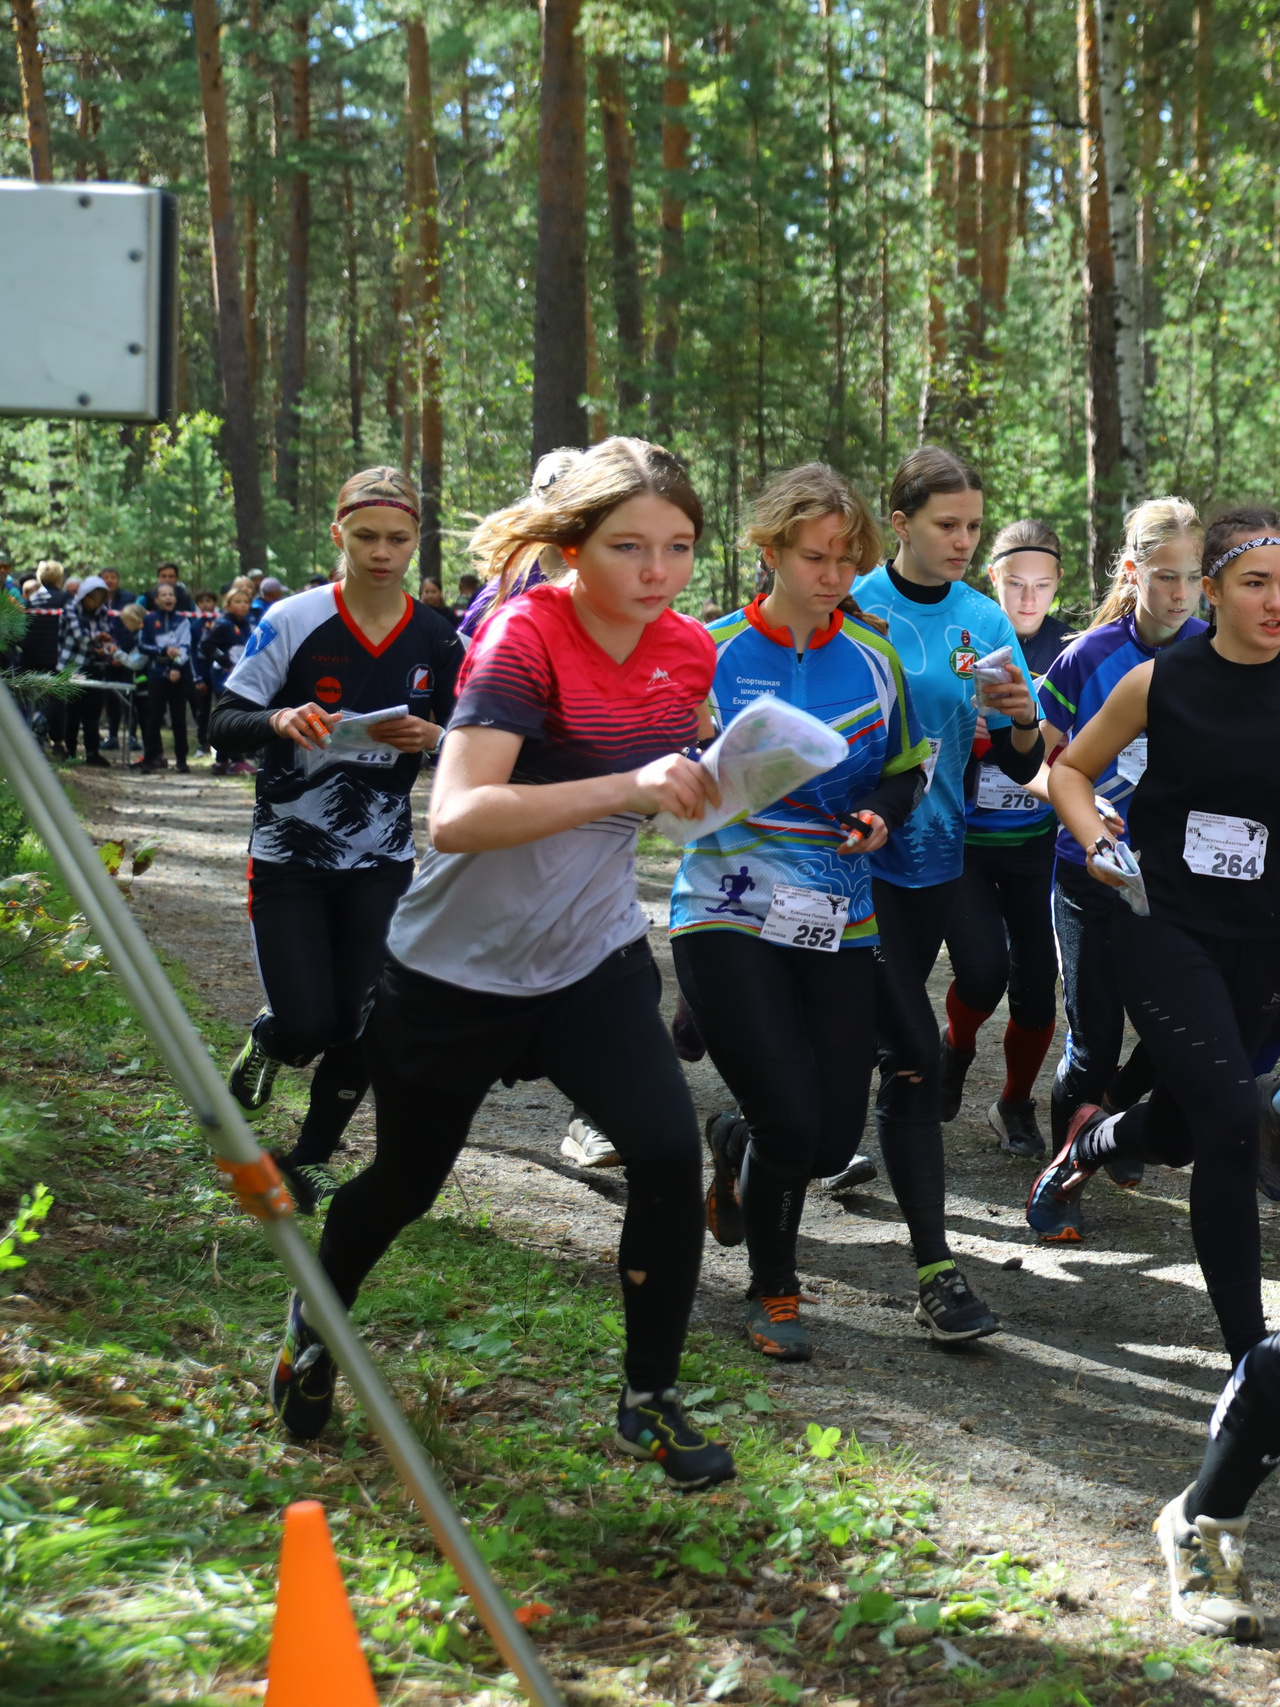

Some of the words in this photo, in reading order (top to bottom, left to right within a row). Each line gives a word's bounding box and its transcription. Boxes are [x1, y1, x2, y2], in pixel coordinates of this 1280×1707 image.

[736, 676, 781, 687] Спортивная
[1001, 793, 1035, 809] 276
[1211, 852, 1258, 878] 264
[792, 924, 837, 949] 252
